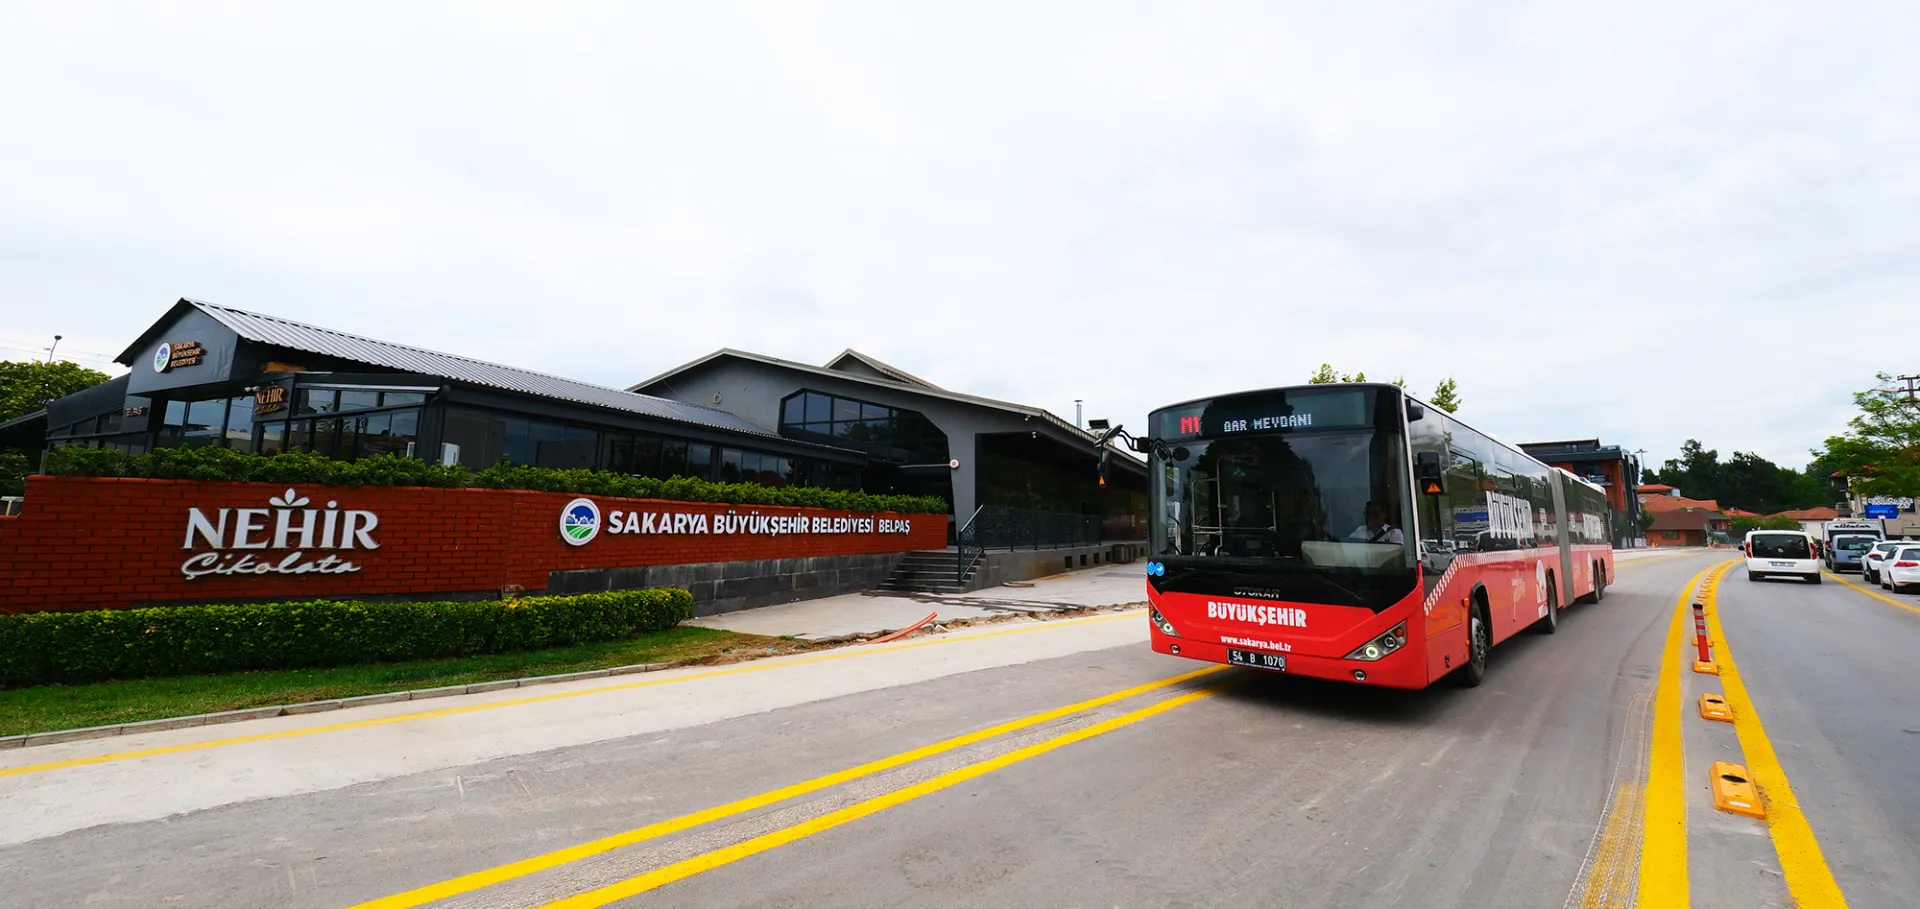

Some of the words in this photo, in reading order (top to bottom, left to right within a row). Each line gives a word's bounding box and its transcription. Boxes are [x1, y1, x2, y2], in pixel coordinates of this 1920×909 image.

[1180, 415, 1199, 434] M1
[1253, 413, 1312, 430] MEYDANI
[181, 499, 381, 550] NEHİR
[607, 510, 709, 534] SAKARYA
[713, 510, 810, 537] BÜYÜKŞEHİR
[811, 513, 874, 534] BELEDİYESİ
[878, 519, 911, 535] BELPAŞ
[181, 551, 361, 580] Çikolata
[1234, 586, 1280, 598] OTOKAR
[1207, 601, 1307, 627] BÜYÜKŞEHİR
[1220, 635, 1291, 652] www.sakarya.bel.tr
[1232, 650, 1243, 662] 54
[1249, 653, 1256, 664] B
[1263, 655, 1284, 667] 1070
